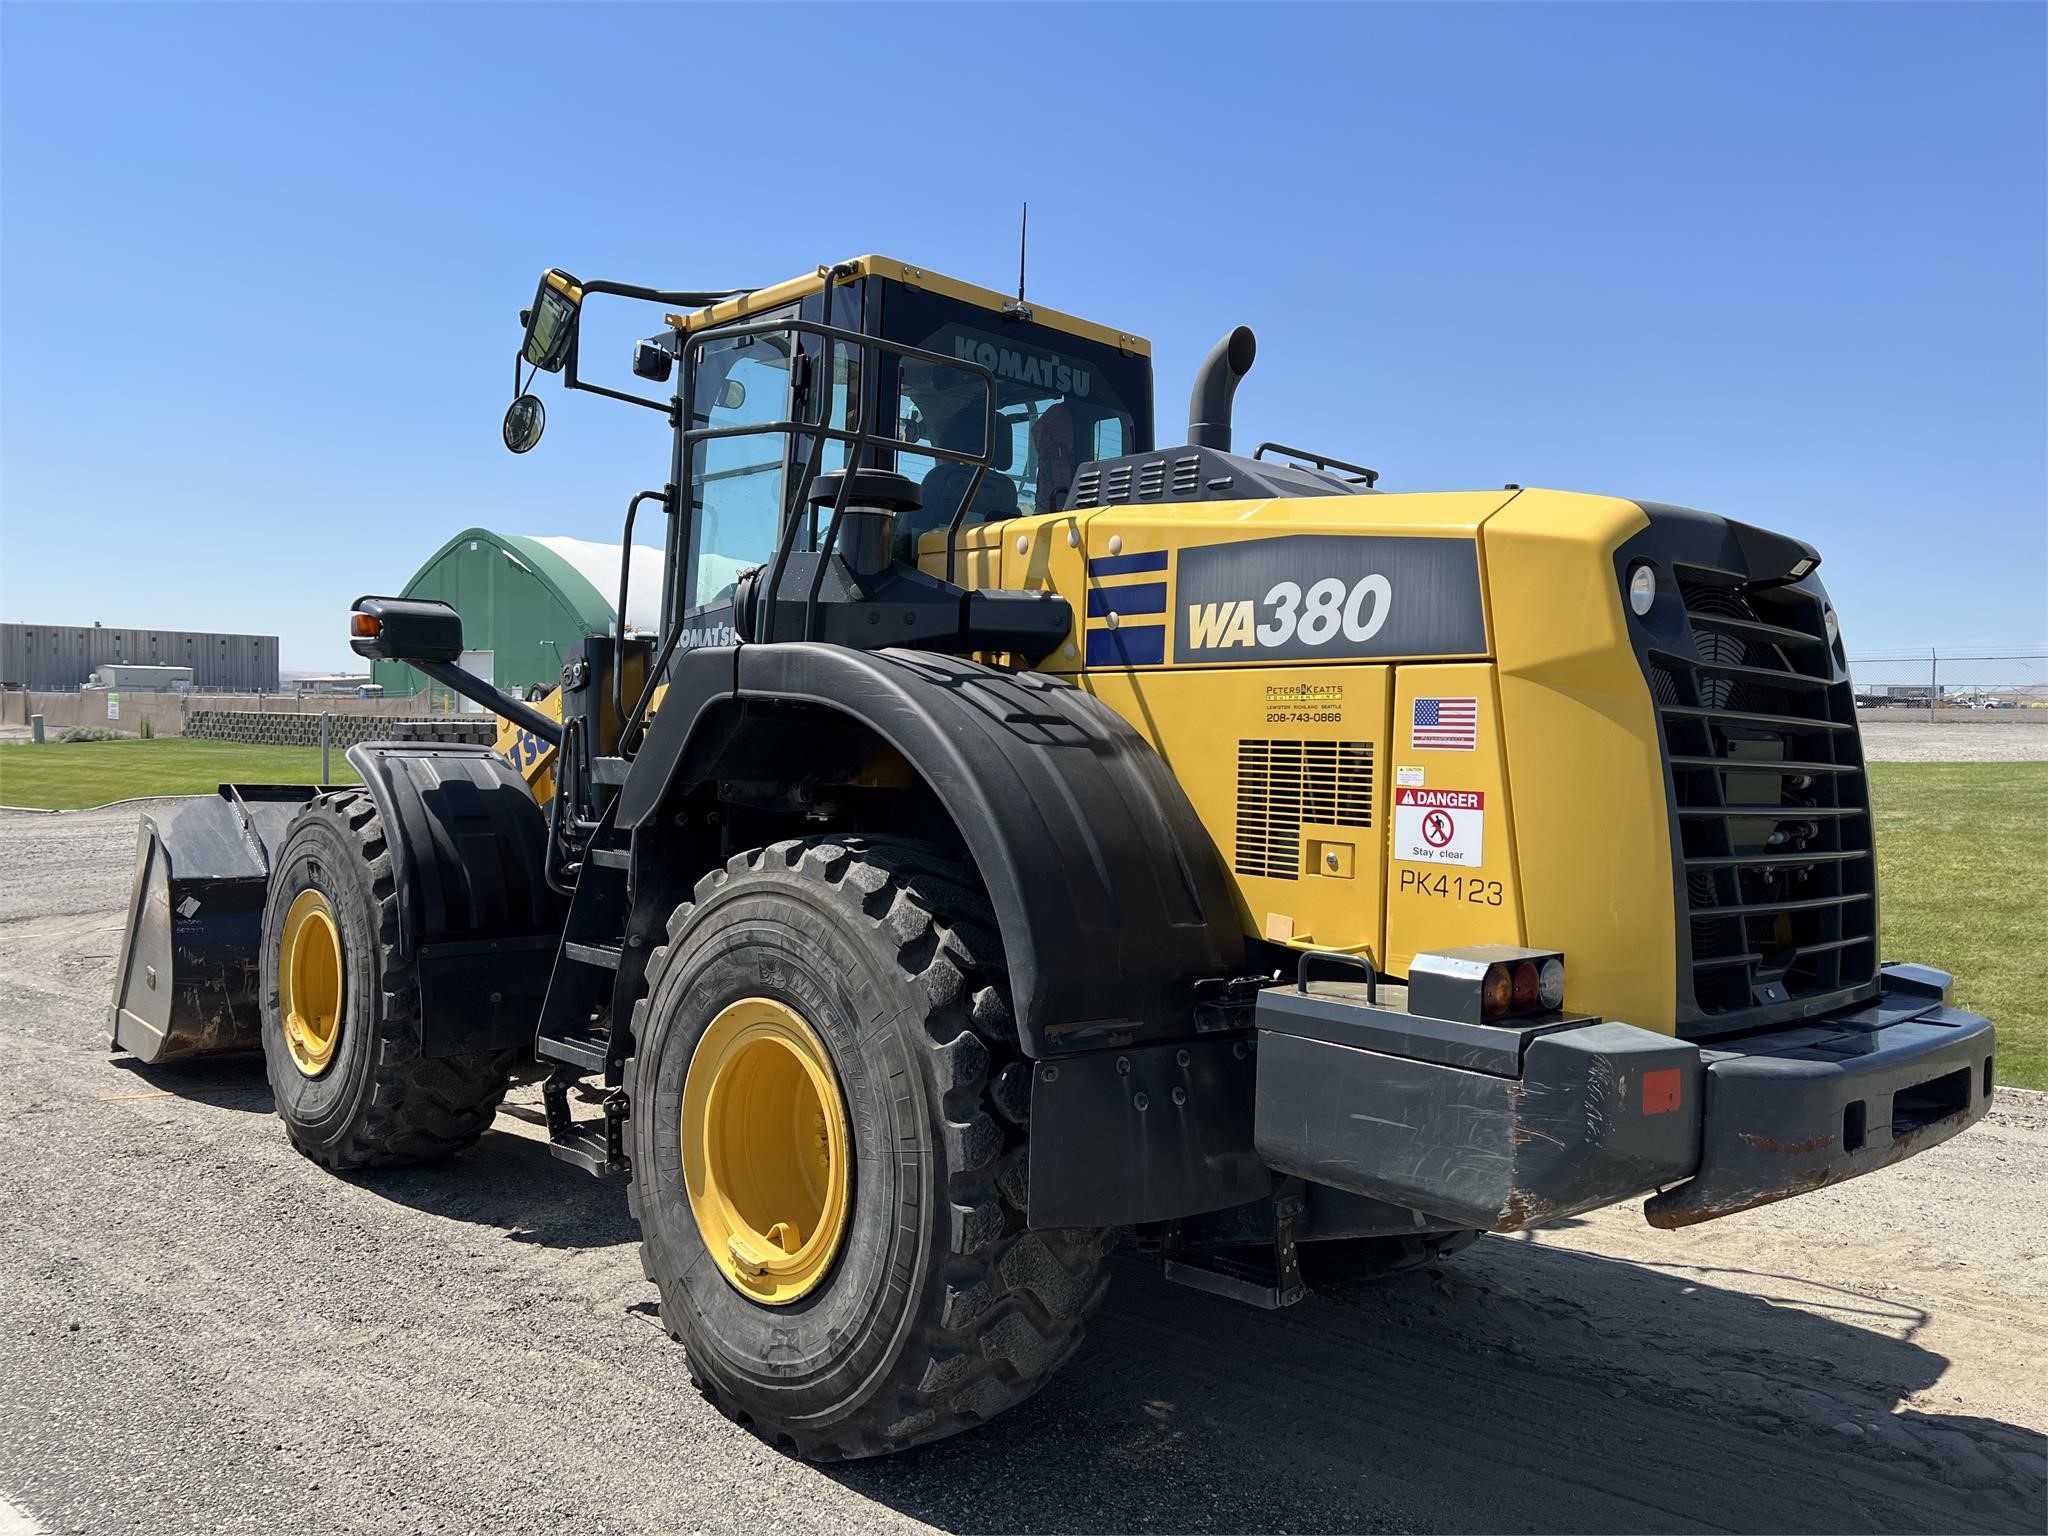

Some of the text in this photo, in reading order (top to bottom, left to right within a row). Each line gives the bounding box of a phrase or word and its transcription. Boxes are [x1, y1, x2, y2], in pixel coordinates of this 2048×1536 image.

[955, 335, 1090, 397] KOMATSU
[1189, 574, 1392, 649] WA380
[676, 621, 738, 648] OMATS
[1266, 685, 1343, 694] PETERS KEATTS
[1266, 713, 1342, 722] 208-743-0866
[1417, 791, 1478, 807] DANGER
[1413, 847, 1464, 859] Stay clear
[1400, 869, 1503, 906] PK4123
